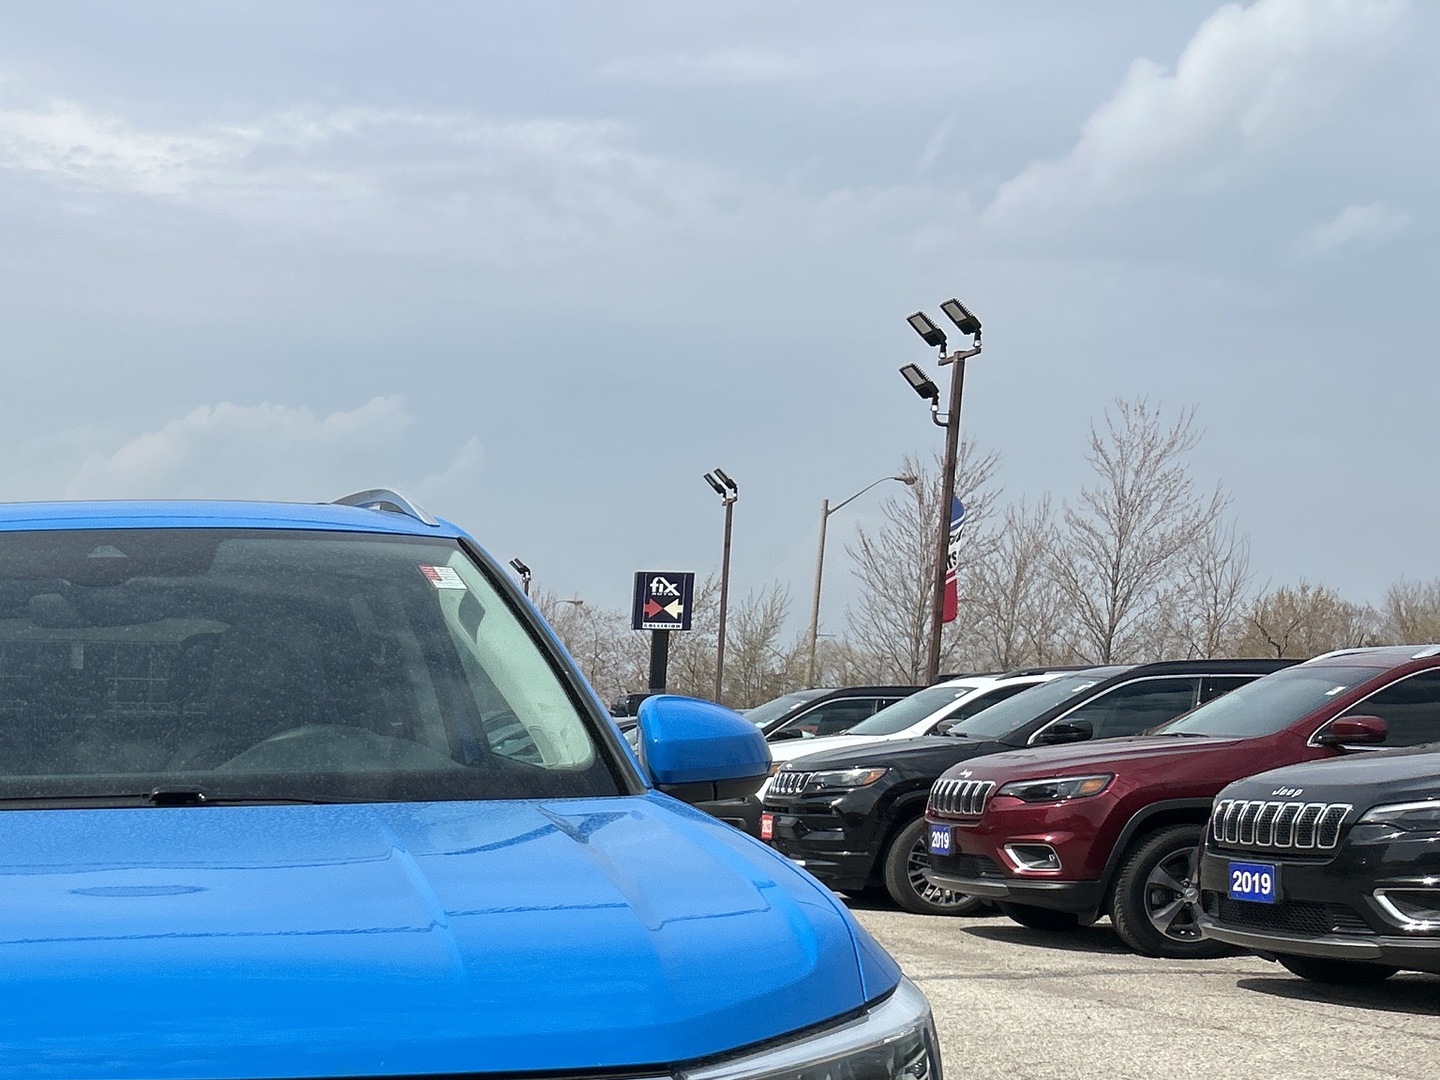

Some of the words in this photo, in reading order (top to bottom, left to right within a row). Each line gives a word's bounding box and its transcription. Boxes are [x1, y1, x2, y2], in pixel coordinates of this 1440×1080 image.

[649, 576, 681, 597] fix
[1271, 786, 1304, 798] Jeep
[931, 830, 950, 850] 2019
[1232, 870, 1271, 894] 2019
